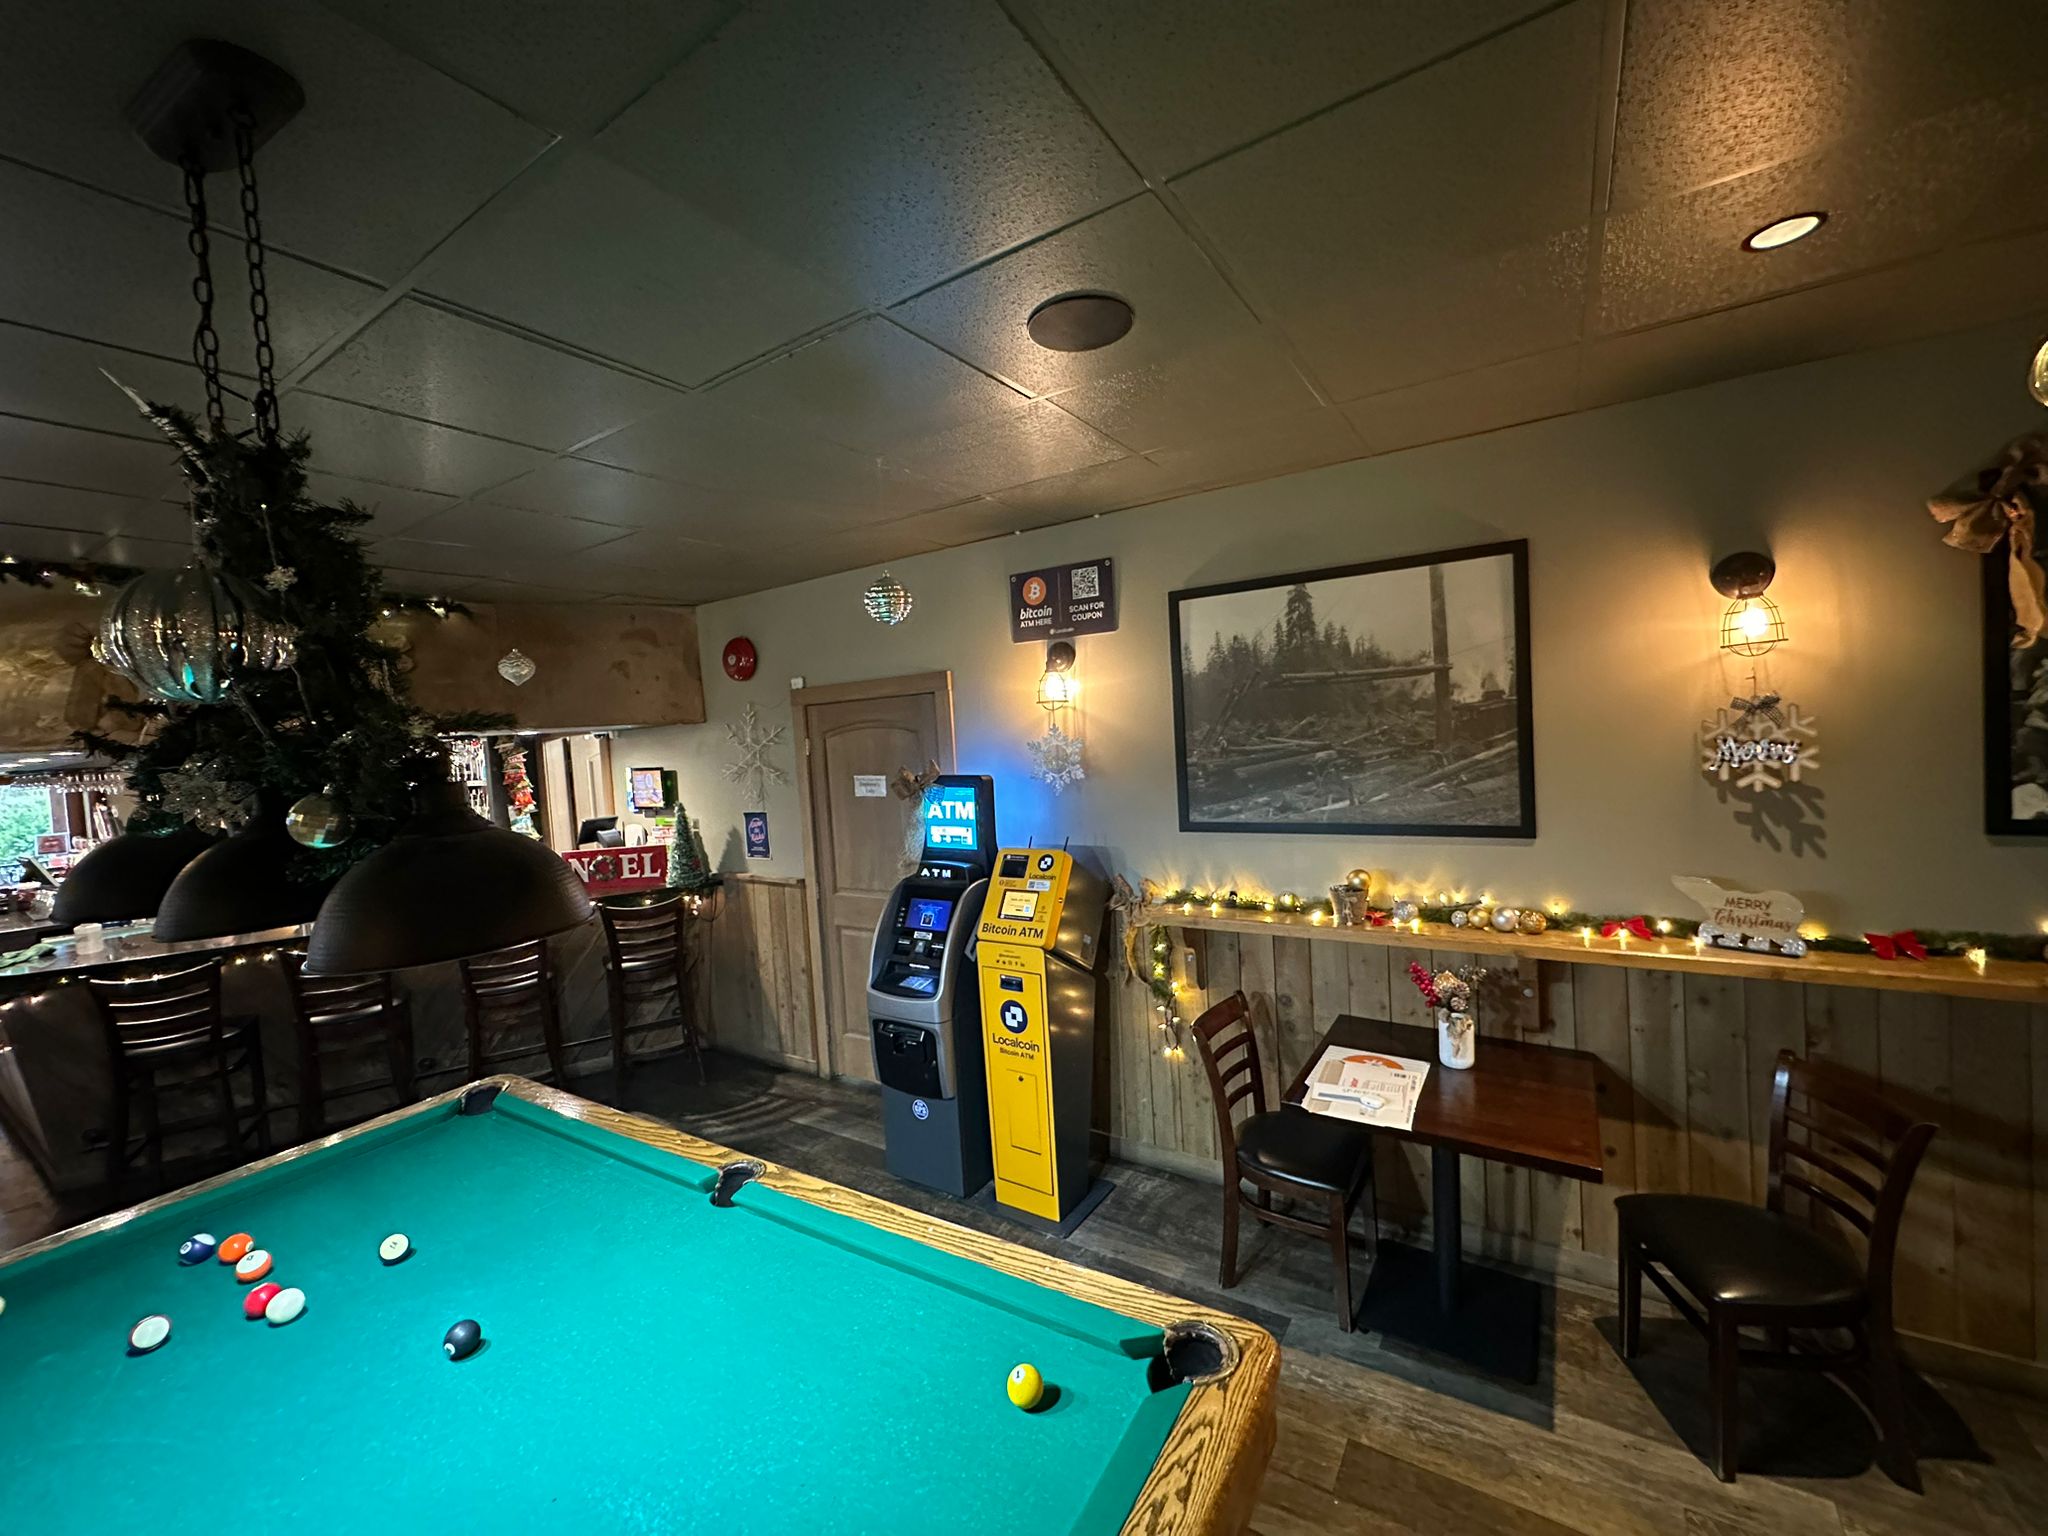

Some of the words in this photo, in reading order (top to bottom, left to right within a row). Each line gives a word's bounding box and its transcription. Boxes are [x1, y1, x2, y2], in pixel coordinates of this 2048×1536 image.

[1020, 605, 1053, 620] bitcoin
[1069, 604, 1089, 613] SCAN
[1090, 601, 1105, 610] FOR
[1020, 620, 1035, 628] ATM
[1036, 617, 1053, 626] HERE
[1072, 611, 1103, 621] COUPON
[927, 801, 975, 820] ATM
[921, 867, 951, 879] ATM
[1724, 897, 1772, 911] MERRY
[1713, 908, 1793, 932] Christmas
[982, 923, 1018, 936] Bitcoin
[1018, 926, 1044, 939] ATM
[992, 1033, 1040, 1052] Localcoin
[1020, 1052, 1034, 1060] ATM
